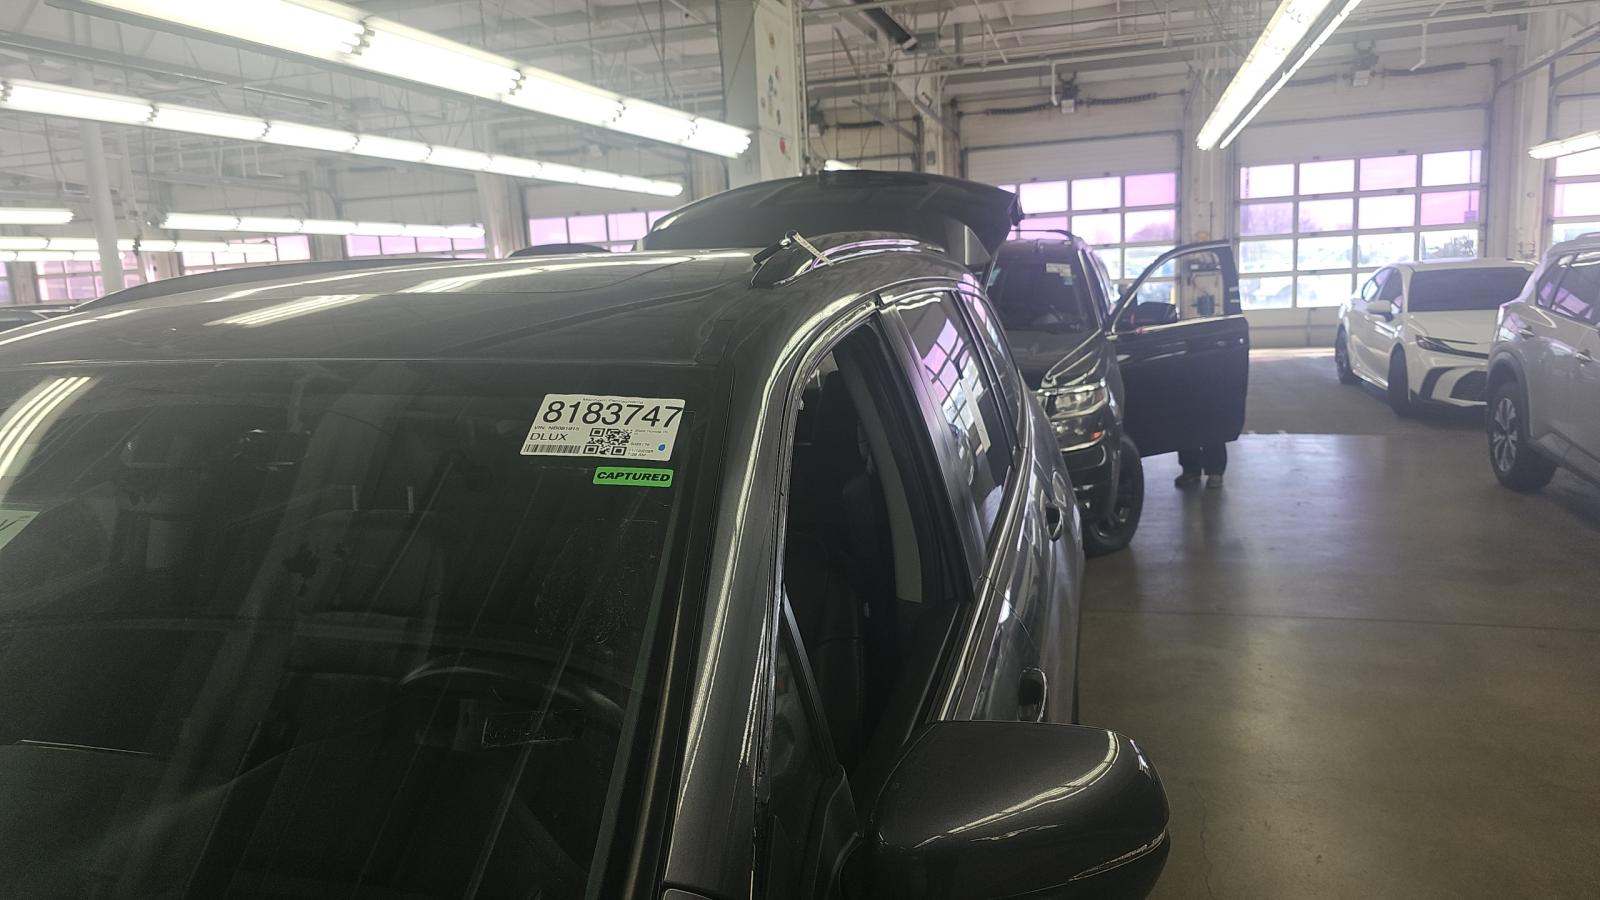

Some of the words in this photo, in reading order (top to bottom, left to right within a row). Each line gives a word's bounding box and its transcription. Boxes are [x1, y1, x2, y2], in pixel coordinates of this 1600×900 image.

[542, 400, 684, 428] 8183747
[530, 432, 569, 441] DLUX
[596, 470, 671, 482] CAPTURED
